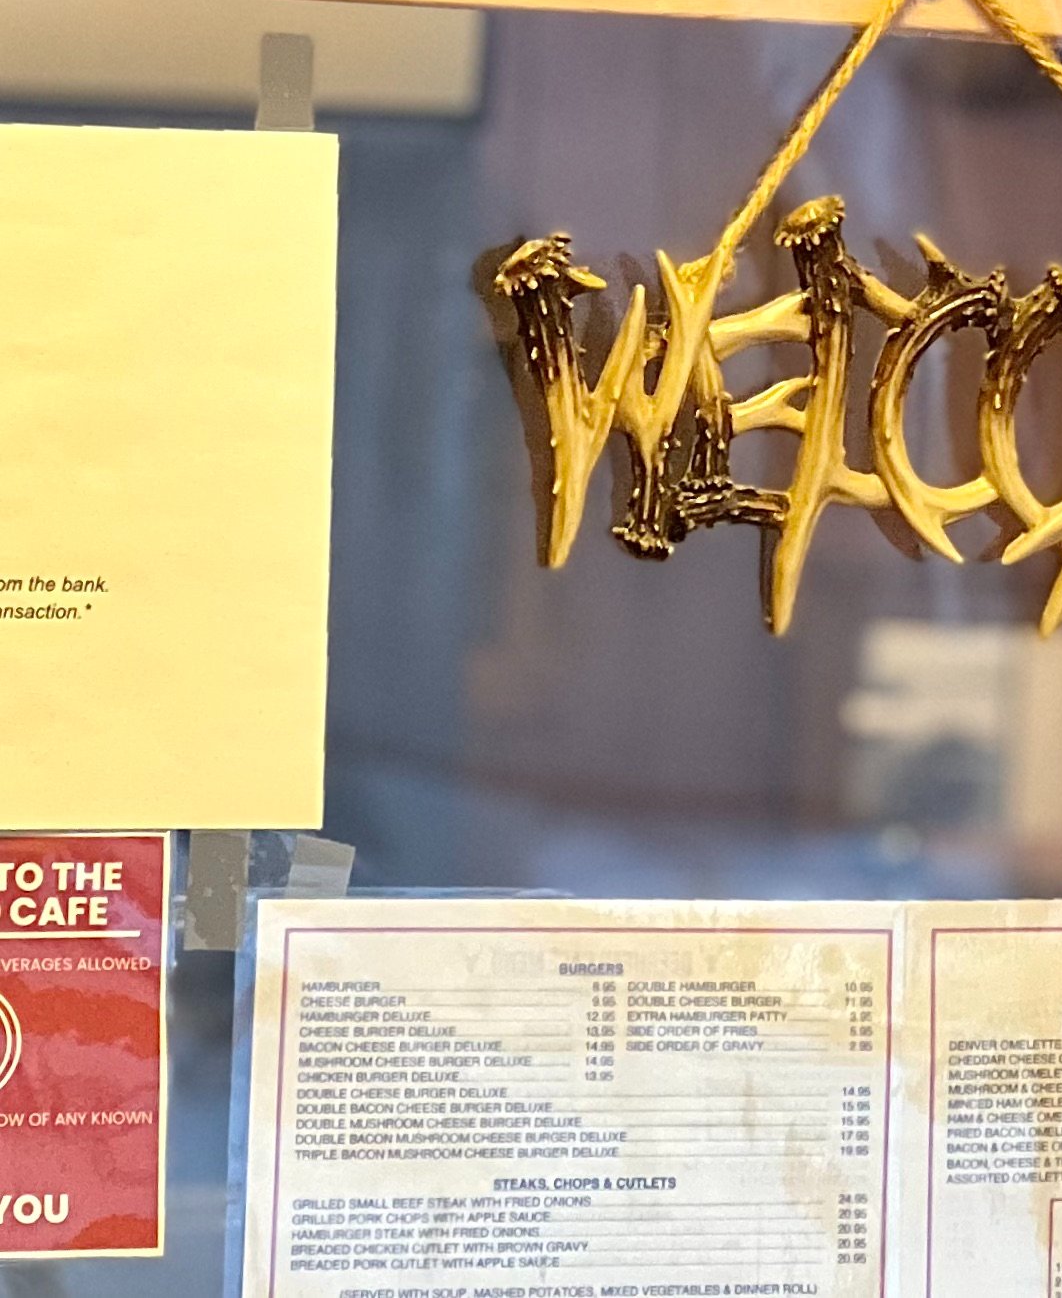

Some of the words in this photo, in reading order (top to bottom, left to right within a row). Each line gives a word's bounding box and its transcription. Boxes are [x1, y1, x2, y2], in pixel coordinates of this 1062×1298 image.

[29, 576, 56, 592] the
[62, 577, 108, 592] bank.
[0, 603, 91, 619] nsaction.
[0, 862, 43, 891] TO
[52, 862, 122, 891] THE
[10, 897, 108, 926] CAFE
[77, 957, 151, 971] ALLOWED
[559, 963, 624, 975] BURGERS
[302, 982, 380, 991] HAMBURGER
[627, 982, 675, 991] DOUBLE
[680, 982, 756, 991] HAMBURGER
[301, 997, 350, 1007] CHEESE
[354, 997, 406, 1006] BURGER
[627, 997, 675, 1006] DOUBLE
[680, 997, 727, 1006] CHEESE
[732, 997, 781, 1006] BURGER
[301, 1012, 379, 1022] HAMBURGER
[383, 1012, 431, 1021] DELUXE
[627, 1012, 667, 1021] EXTRA
[670, 1012, 746, 1021] HAMBURGER
[750, 1012, 787, 1021] PATTY
[300, 1027, 349, 1037] CHEESE
[353, 1027, 405, 1036] BURGER
[409, 1027, 456, 1036] DELUXE
[626, 1026, 653, 1036] SIDE
[657, 1026, 700, 1036] ORDER
[704, 1026, 719, 1036] OF
[723, 1026, 757, 1036] FRIES
[299, 1042, 342, 1052] BACON
[345, 1042, 395, 1052] CHEESE
[399, 1041, 450, 1051] BURGER
[454, 1041, 502, 1051] DELUXE
[626, 1041, 653, 1051] SIDE
[657, 1041, 699, 1051] ORDER
[703, 1041, 719, 1051] OF
[723, 1041, 764, 1051] GRAVY
[949, 1040, 997, 1051] DENVER
[1000, 1039, 1062, 1049] OMELETTE
[299, 1057, 372, 1067] MUSHROOM
[376, 1057, 425, 1067] CHEESE
[429, 1057, 480, 1066] BURGER
[484, 1057, 532, 1066] DELUXE
[949, 1055, 1005, 1065] CHEDDAR
[1009, 1054, 1056, 1064] CHEESE
[298, 1073, 352, 1082] CHICKEN
[357, 1072, 408, 1082] BURGER
[412, 1072, 460, 1082] DELUXE
[948, 1070, 1019, 1080] MUSHROOM
[297, 1089, 347, 1099] DOUBLE
[351, 1089, 400, 1098] CHEESE
[404, 1088, 455, 1098] BURGER
[460, 1088, 508, 1098] DELUXE
[297, 1104, 346, 1114] DOUBLE
[351, 1104, 393, 1113] BACON
[397, 1103, 446, 1113] CHEESE
[450, 1103, 501, 1113] BURGER
[505, 1103, 552, 1112] DELUXE
[29, 1113, 50, 1127] OF
[55, 1112, 86, 1125] ANY
[92, 1111, 152, 1125] KNOWN
[296, 1119, 345, 1129] DOUBLE
[350, 1119, 424, 1129] MUSHROOM
[427, 1118, 476, 1128] CHEESE
[480, 1118, 530, 1127] BURGER
[535, 1118, 581, 1127] DELUXE
[296, 1134, 345, 1144] DOUBLE
[350, 1134, 393, 1144] BACON
[396, 1134, 470, 1143] MUSHROOM
[473, 1133, 521, 1143] CHEESE
[525, 1133, 576, 1142] BURGER
[580, 1132, 627, 1142] DELUXE
[994, 1157, 1041, 1168] CHEESE
[1044, 1158, 1051, 1167] &
[494, 1178, 548, 1191] STEAKS,
[554, 1178, 600, 1189] CHOPS
[604, 1177, 612, 1189] &
[617, 1177, 676, 1189] CUTLETS
[947, 1173, 1009, 1184] ASSORTED
[293, 1199, 345, 1210] GRILLED
[350, 1199, 388, 1209] SMALL
[393, 1199, 423, 1209] BEEF
[428, 1198, 467, 1208] STEAK
[471, 1198, 500, 1208] WITH
[505, 1197, 540, 1208] FRIED
[544, 1197, 591, 1207] ONIONS
[292, 1215, 344, 1225] GRILLED
[349, 1214, 382, 1224] PORK
[386, 1213, 429, 1223] CHOPS
[433, 1213, 464, 1222] WITH
[468, 1212, 506, 1222] APPLE
[509, 1212, 550, 1222] SAUCE
[291, 1245, 350, 1255] BREADED
[354, 1244, 409, 1254] CHICKEN
[412, 1244, 459, 1254] CUTLET
[463, 1243, 493, 1253] WITH
[498, 1243, 543, 1252] BROWN
[546, 1242, 588, 1252] GRAVY
[291, 1260, 349, 1270] BREADED
[353, 1259, 386, 1269] PORK
[391, 1259, 438, 1269] CUTLET
[442, 1259, 473, 1268] WITH
[477, 1258, 515, 1268] APPLE
[519, 1257, 560, 1267] SAUCE
